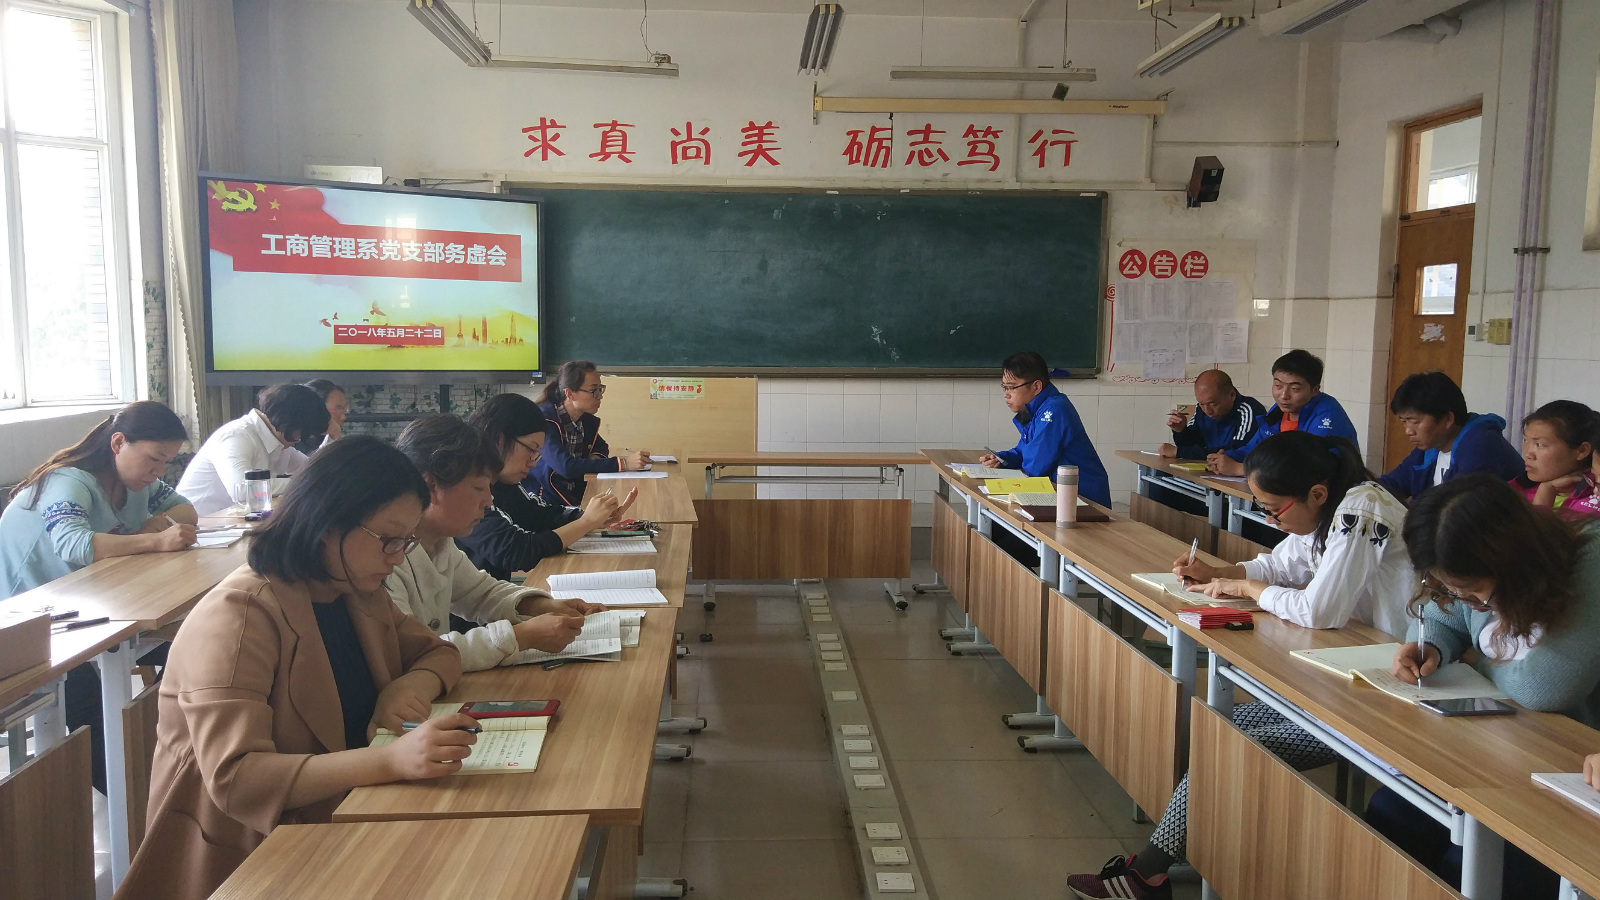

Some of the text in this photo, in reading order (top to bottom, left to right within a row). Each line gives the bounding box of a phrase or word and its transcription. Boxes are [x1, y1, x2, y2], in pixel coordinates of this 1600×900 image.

[521, 116, 1078, 172] 求真尚美 砺志笃行
[261, 233, 507, 266] 工商管理系党支部务虚会
[1122, 254, 1206, 277] 公告栏
